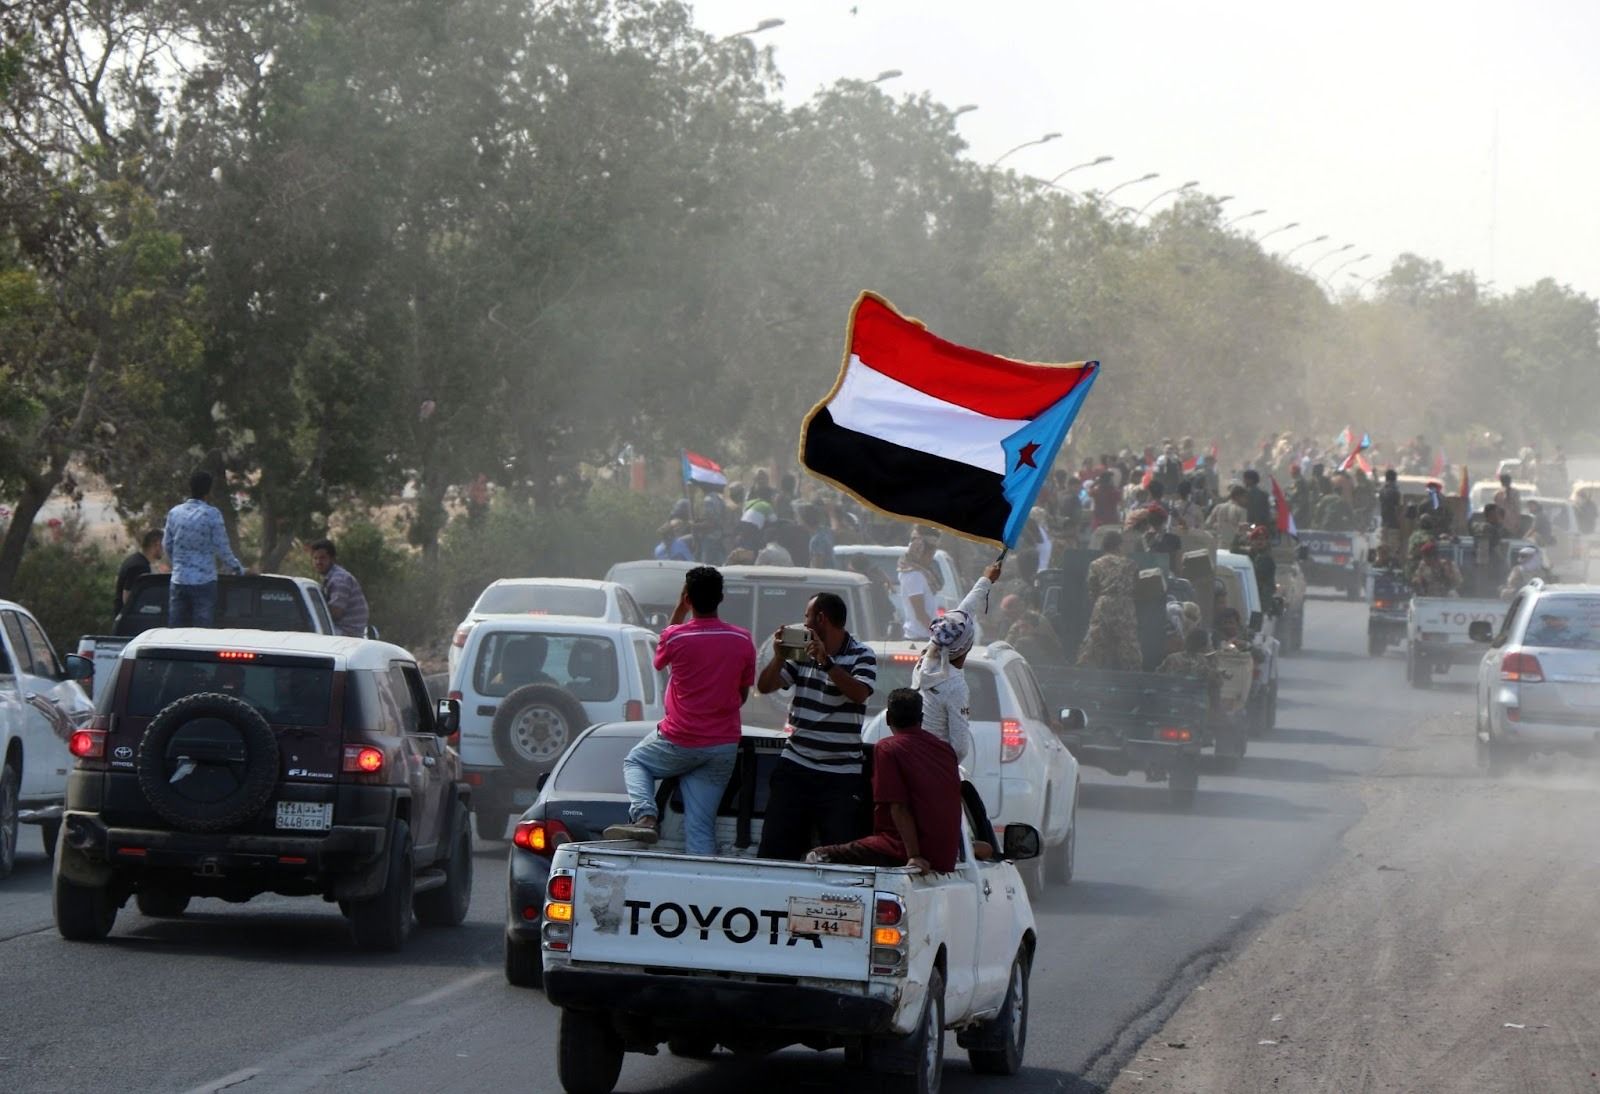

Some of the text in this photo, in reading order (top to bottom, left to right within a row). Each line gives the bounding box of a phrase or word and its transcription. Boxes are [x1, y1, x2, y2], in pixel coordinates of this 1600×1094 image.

[1442, 612, 1506, 625] TOYO
[277, 816, 302, 828] 9448
[813, 920, 839, 932] 144
